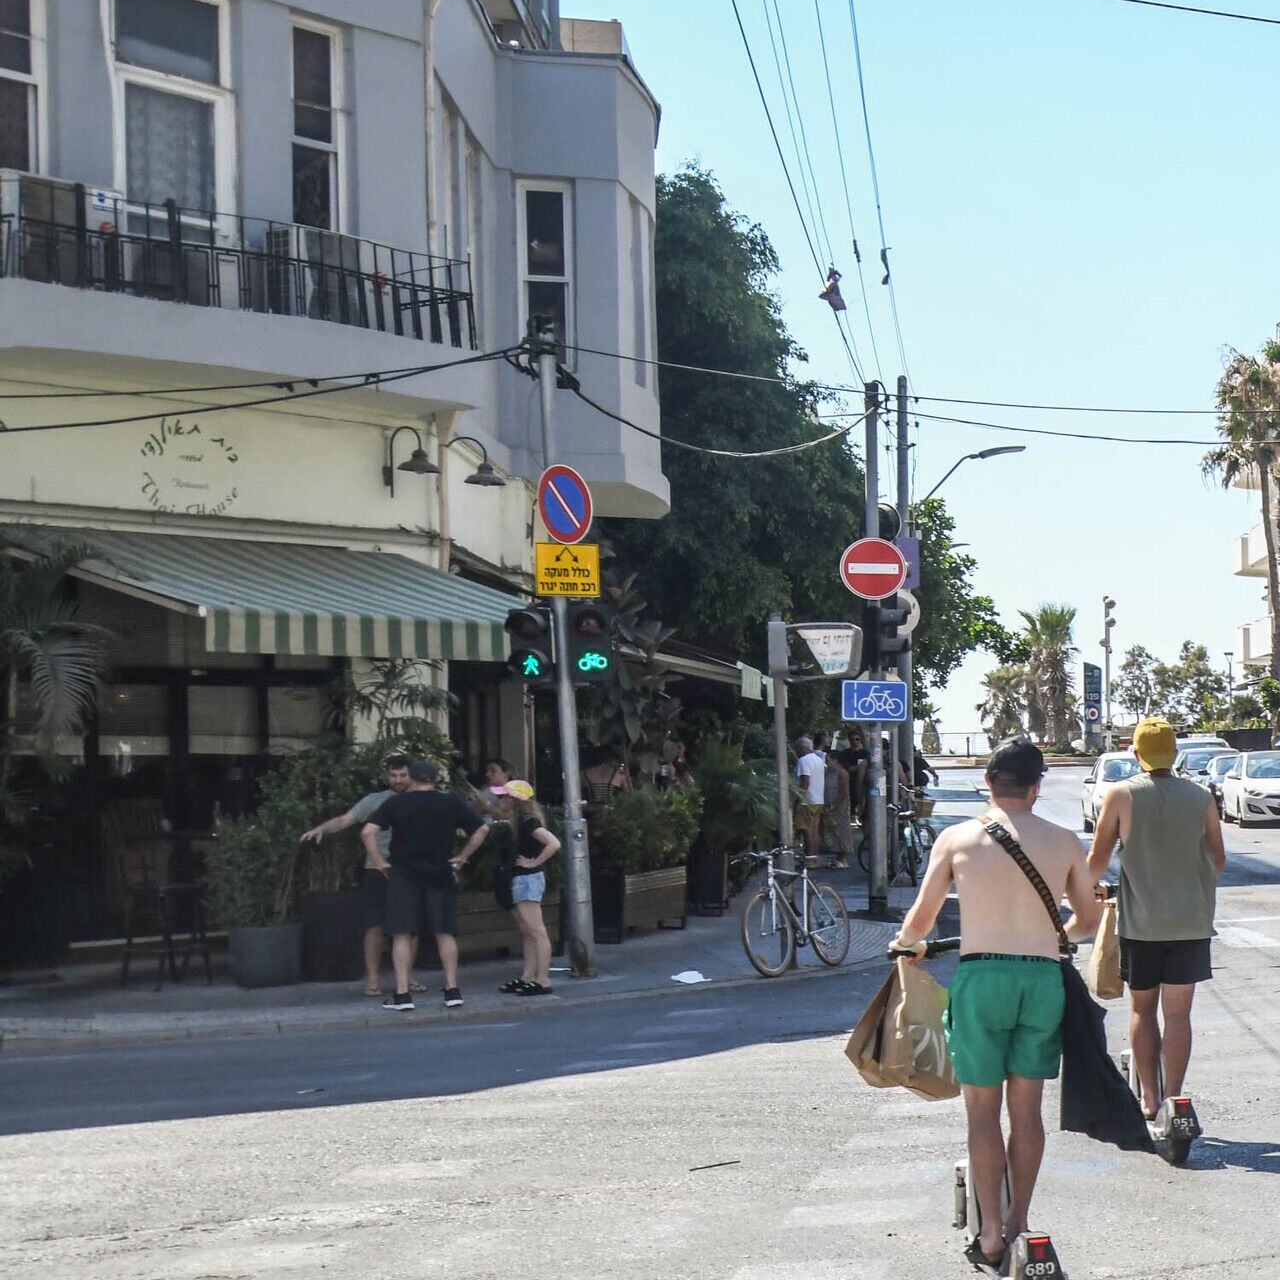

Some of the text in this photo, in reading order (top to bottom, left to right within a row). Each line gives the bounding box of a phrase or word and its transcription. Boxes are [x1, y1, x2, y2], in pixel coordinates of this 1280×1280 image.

[572, 566, 590, 578] כולל
[581, 582, 596, 591] רכב
[1173, 1118, 1195, 1129] 951
